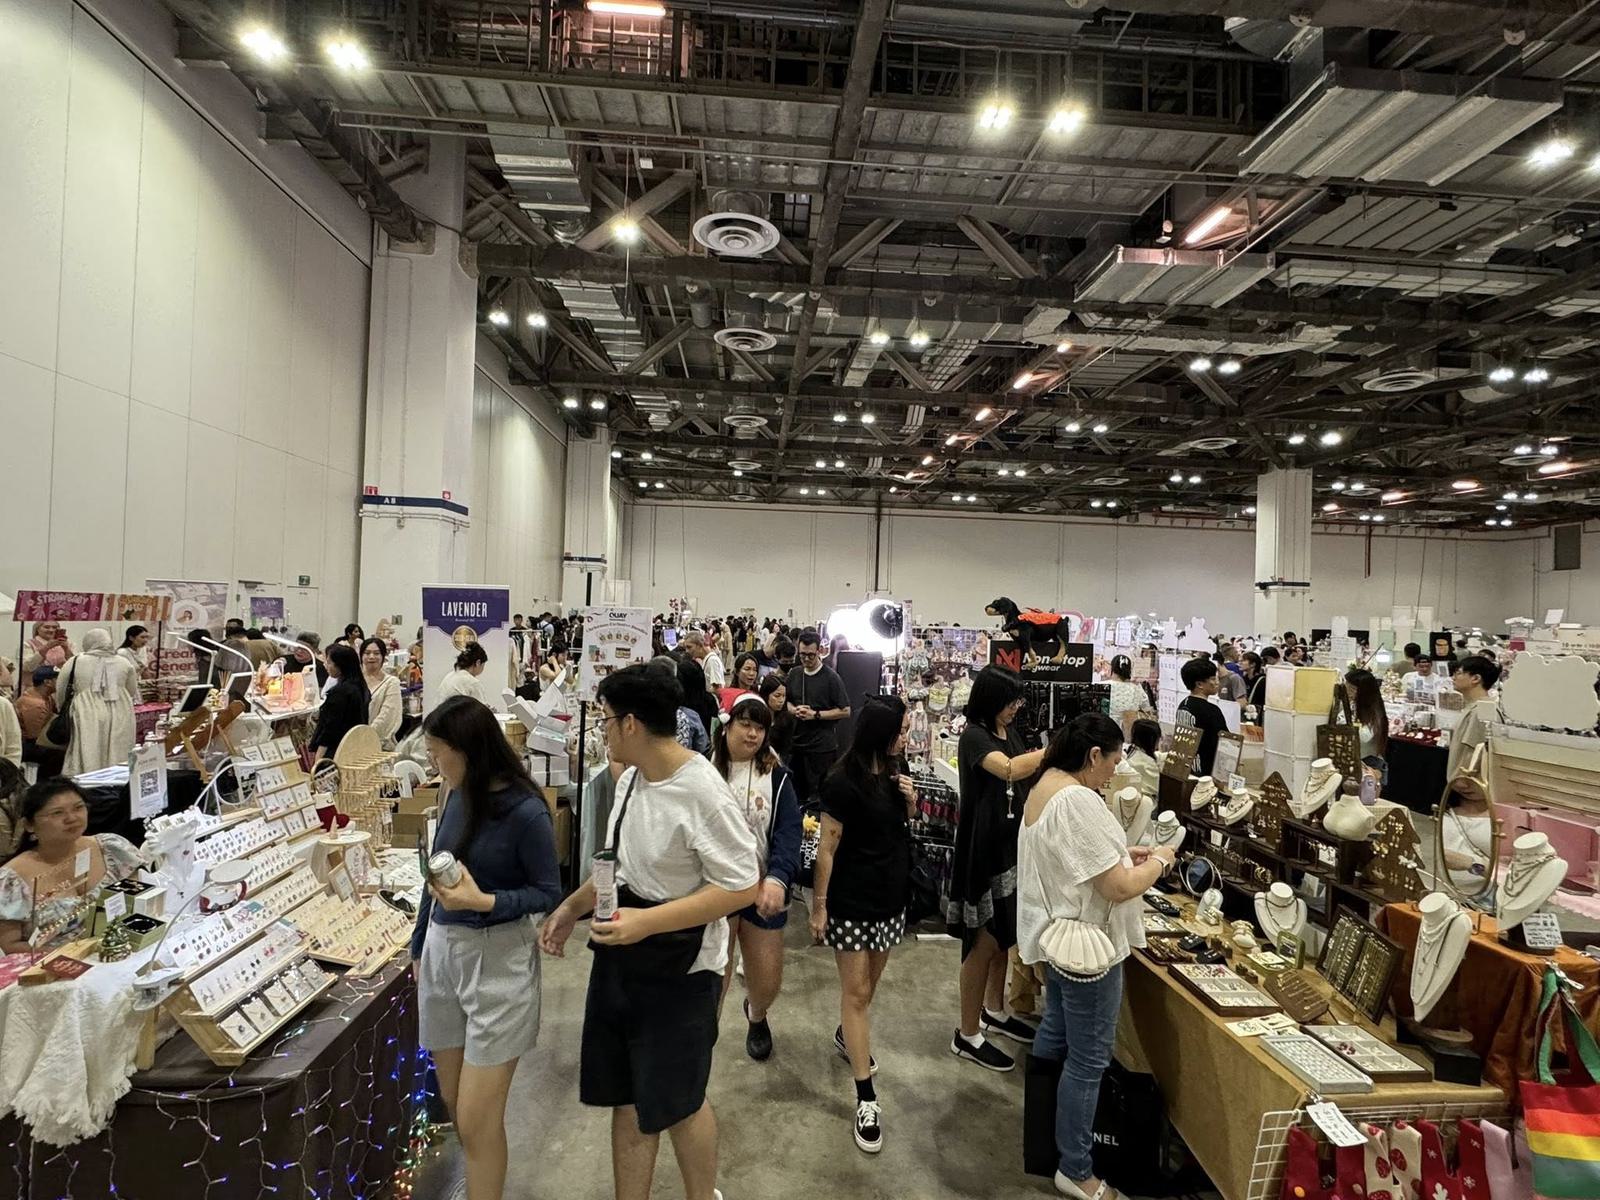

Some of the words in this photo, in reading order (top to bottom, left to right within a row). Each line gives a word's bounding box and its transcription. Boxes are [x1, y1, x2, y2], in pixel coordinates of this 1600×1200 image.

[441, 601, 488, 618] LAVENDER
[147, 660, 195, 671] Gener
[1022, 652, 1086, 668] Non-top
[1093, 1132, 1119, 1146] NEL
